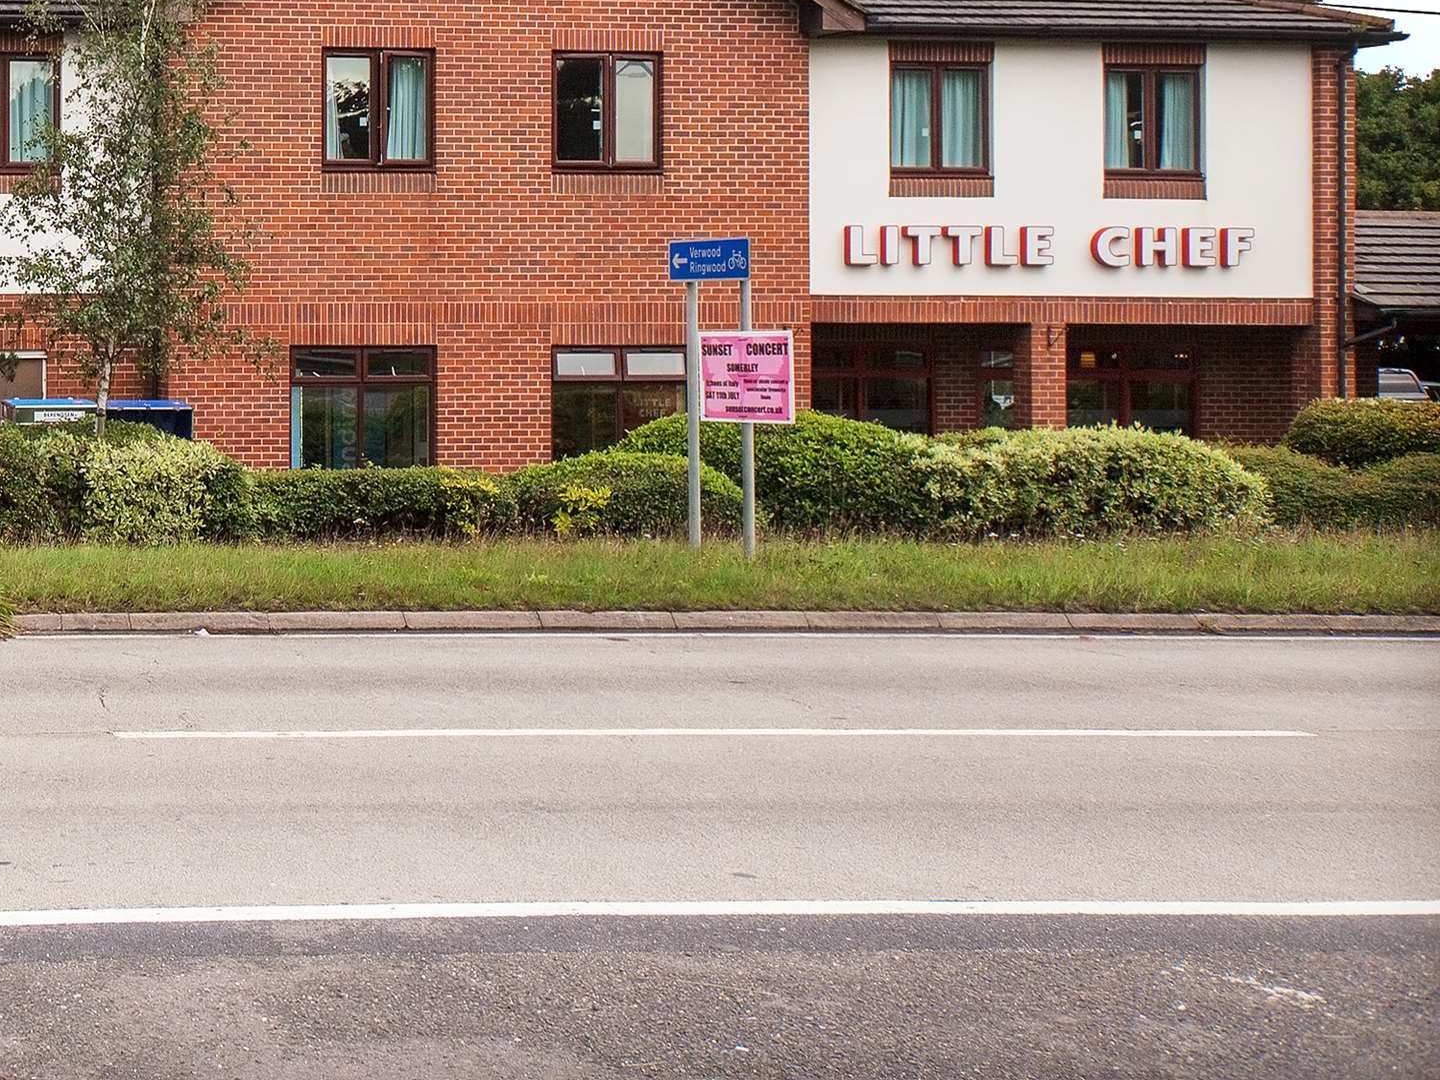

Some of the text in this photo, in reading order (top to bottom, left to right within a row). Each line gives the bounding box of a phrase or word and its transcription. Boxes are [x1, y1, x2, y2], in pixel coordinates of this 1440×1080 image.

[689, 245, 721, 258] Verwood
[844, 225, 1255, 267] LITTLE CHEF
[689, 260, 727, 275] Ringwood
[701, 342, 789, 356] SUNSET CONCERT
